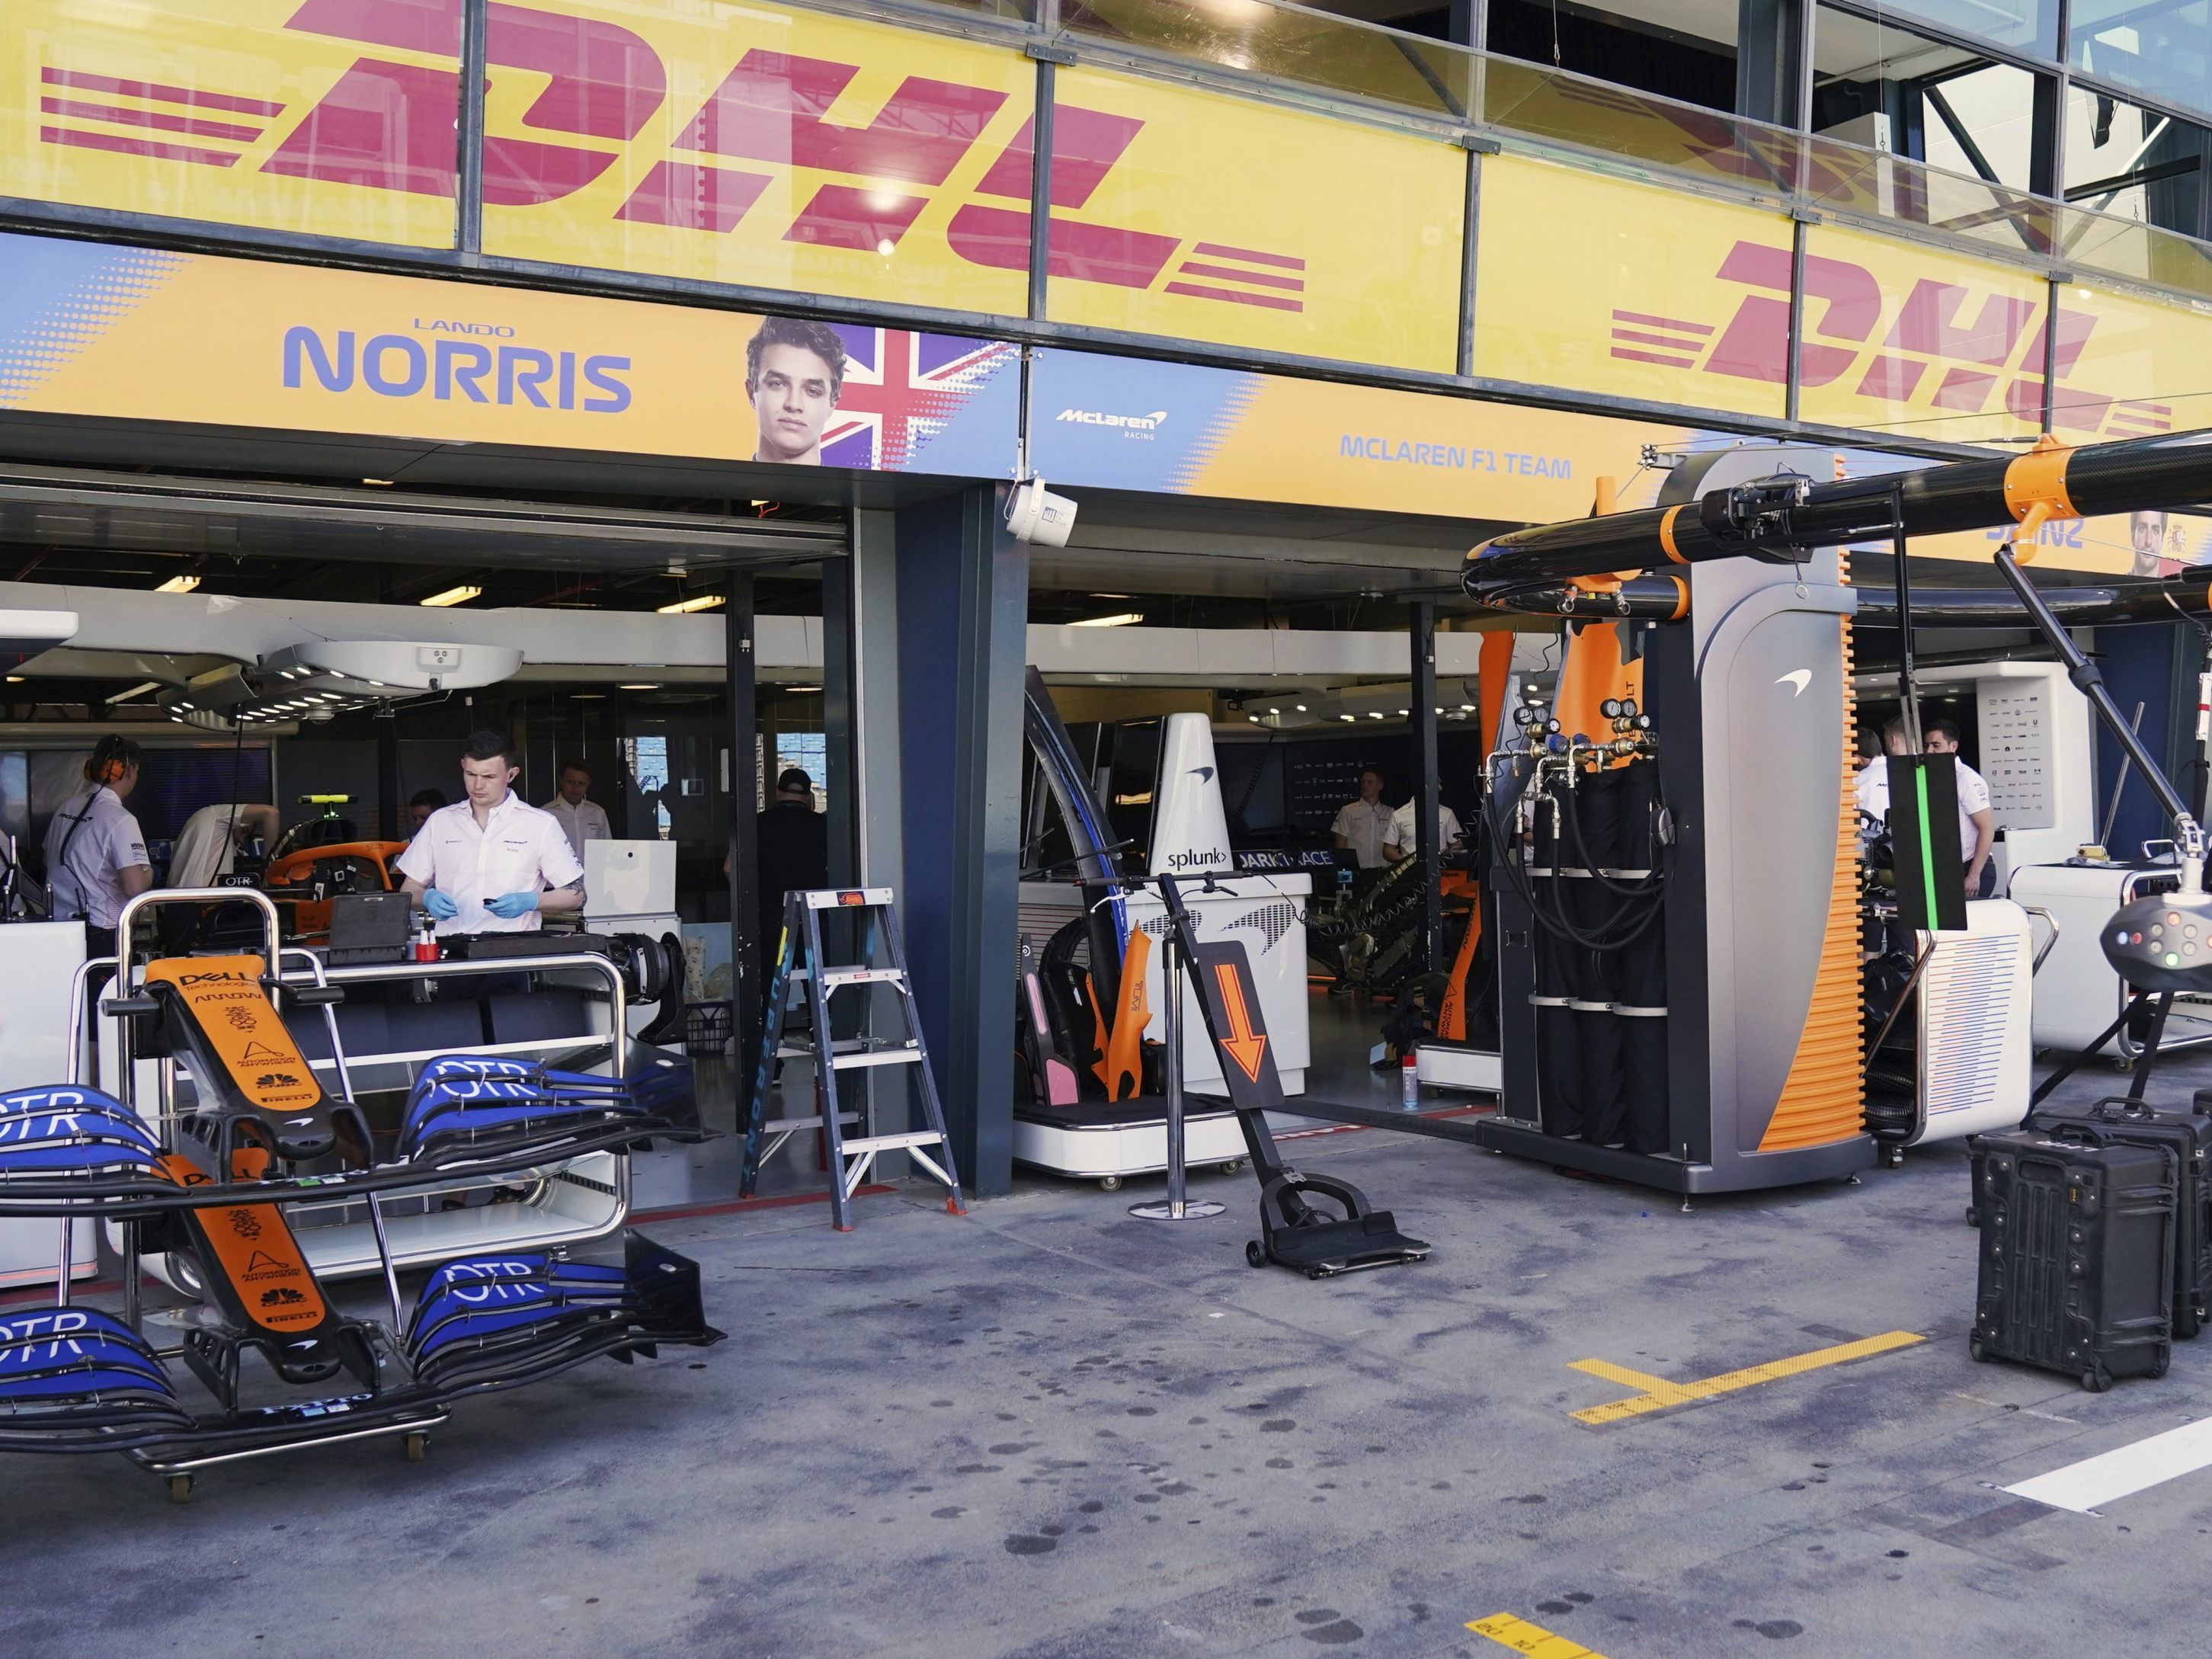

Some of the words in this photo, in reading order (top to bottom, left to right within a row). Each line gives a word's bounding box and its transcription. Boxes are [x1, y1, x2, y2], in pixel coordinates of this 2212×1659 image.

[258, 0, 1183, 290] DHL
[414, 318, 514, 338] LANDO
[1702, 241, 2112, 431] DHL
[283, 325, 631, 413] NORRIS
[1056, 408, 1157, 430] McLaren
[1124, 431, 1155, 440] RACING
[1340, 434, 1465, 468] MCLAREN
[1472, 448, 1497, 472] F1
[1506, 453, 1571, 479] TEAM
[179, 972, 256, 986] DELL
